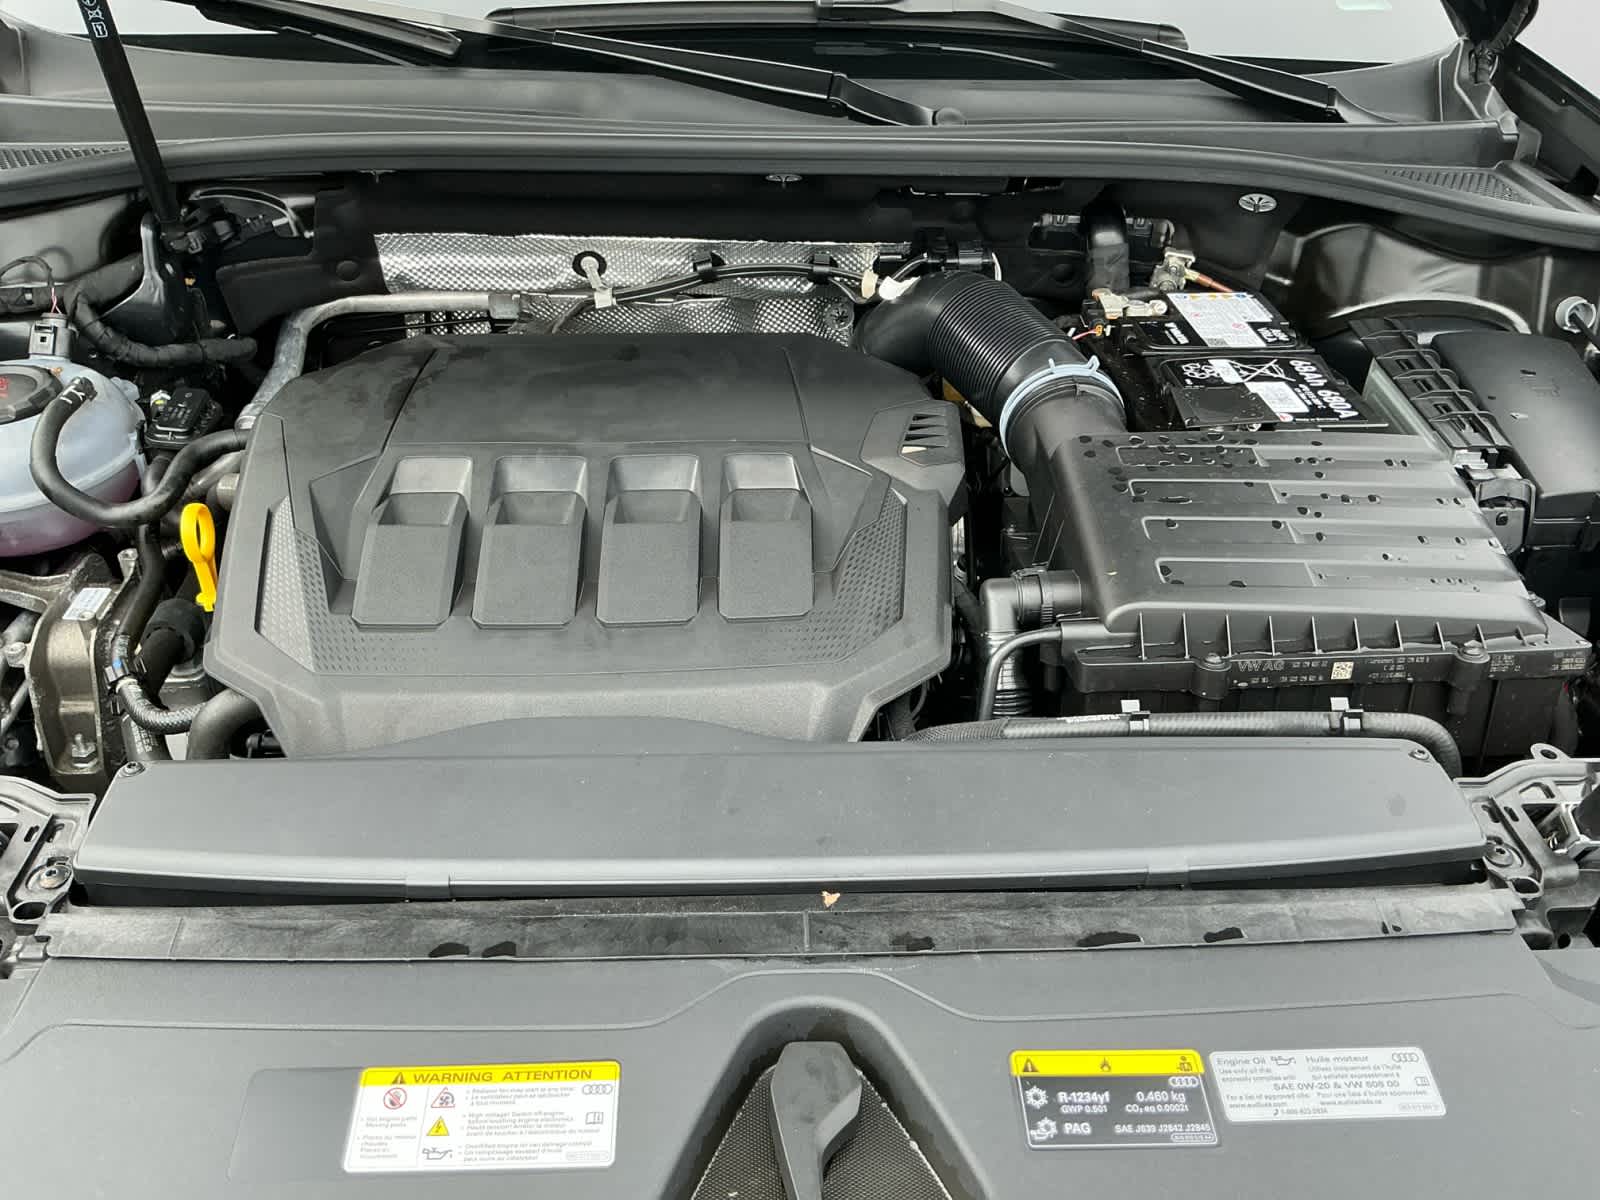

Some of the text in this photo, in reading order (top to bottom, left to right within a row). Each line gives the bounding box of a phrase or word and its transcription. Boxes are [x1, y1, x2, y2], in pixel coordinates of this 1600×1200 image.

[1289, 359, 1328, 386] 68Ah
[1317, 389, 1359, 419] 680A
[1216, 1055, 1266, 1066] Engine Oil
[1305, 1055, 1330, 1063] Huile
[413, 1069, 593, 1084] WARNING ATTENTION
[1273, 1082, 1295, 1090] SAE
[1298, 1081, 1330, 1090] 0W-20
[1333, 1081, 1341, 1089] &
[1057, 1090, 1186, 1104] R-1234yf 0.460 kg
[1064, 1122, 1091, 1135] PAG
[1114, 1124, 1134, 1133] SAE
